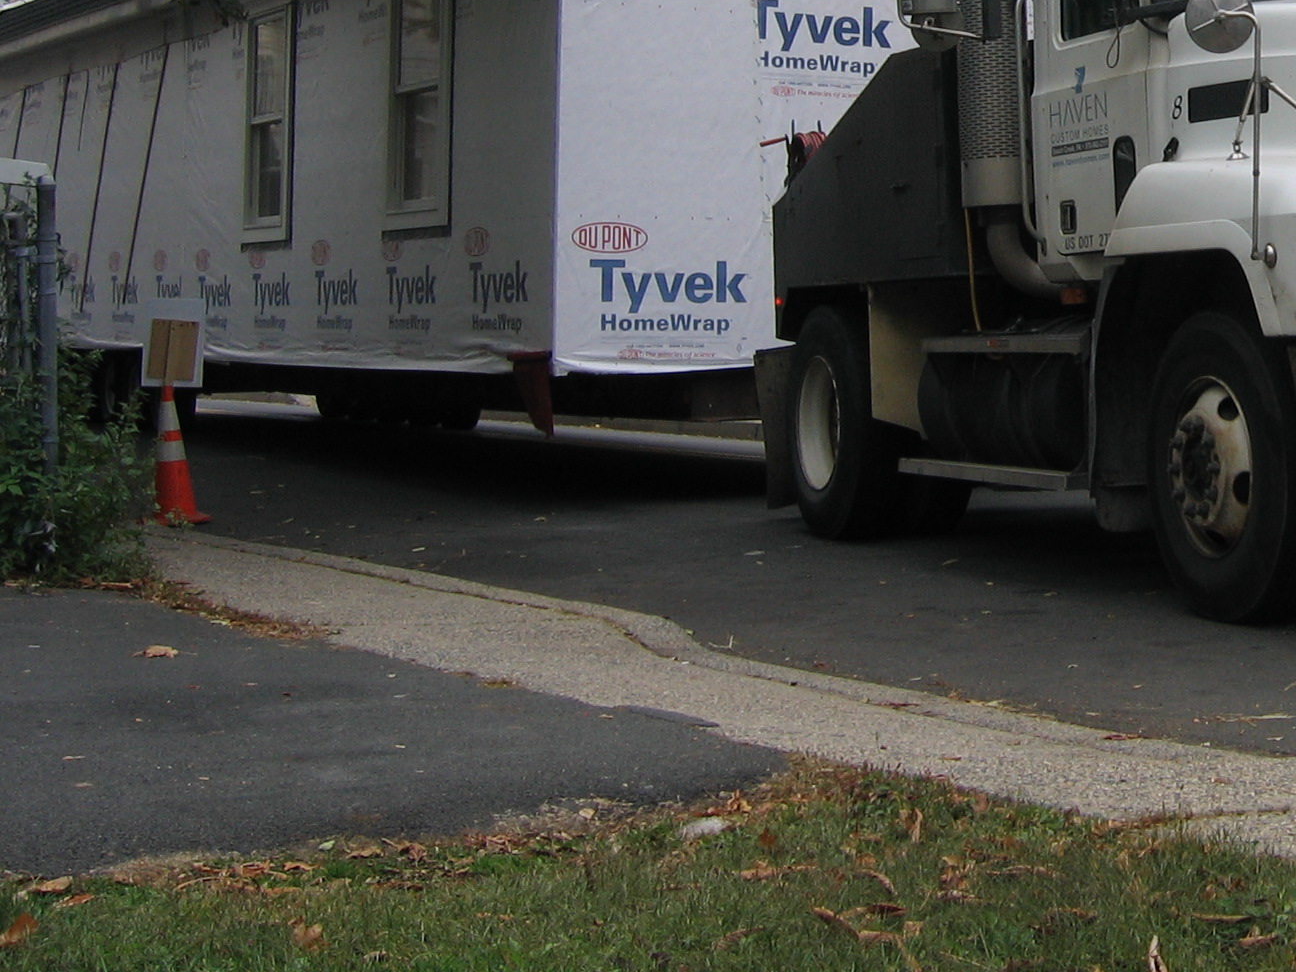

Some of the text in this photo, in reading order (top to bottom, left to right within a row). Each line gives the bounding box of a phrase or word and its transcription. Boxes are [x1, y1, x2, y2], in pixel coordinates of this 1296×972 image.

[1049, 91, 1108, 128] HAVEN
[1172, 95, 1182, 119] 8
[1051, 124, 1109, 144] CUSTOM HOMES
[1065, 237, 1075, 249] US
[198, 275, 231, 315] Tyvek
[253, 272, 290, 315] Tyvek
[315, 269, 357, 315] Tyvek
[386, 265, 436, 314] Tyvek
[469, 260, 528, 314] Tyvek
[590, 259, 747, 314] Tyvek
[601, 314, 730, 335] HomeWrap
